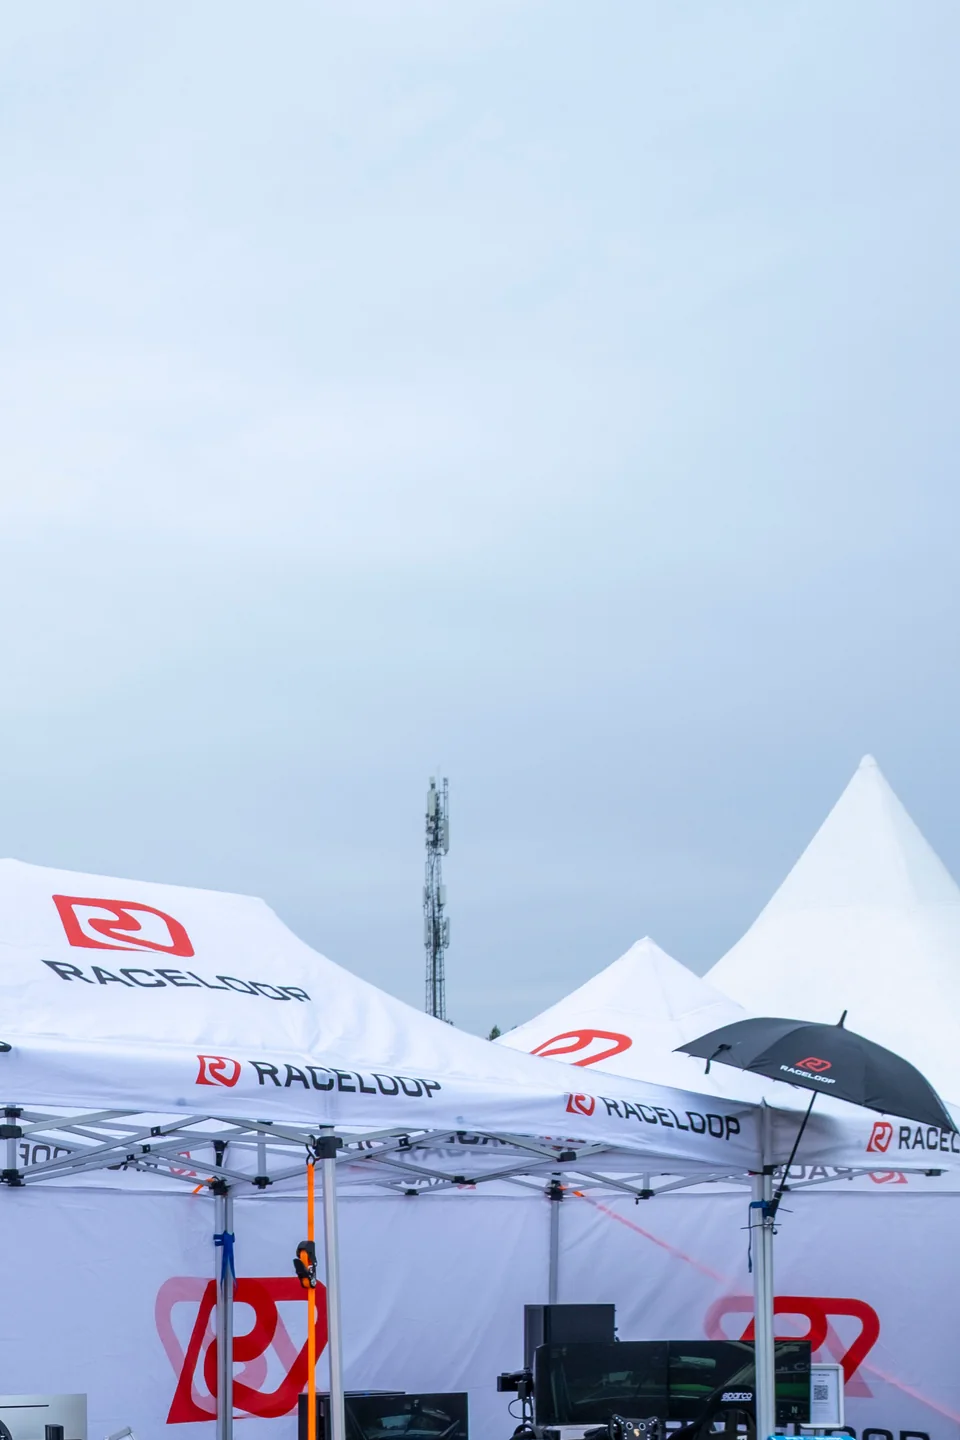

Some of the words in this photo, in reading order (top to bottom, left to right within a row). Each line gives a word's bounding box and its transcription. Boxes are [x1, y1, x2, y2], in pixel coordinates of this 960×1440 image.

[41, 959, 311, 1002] RACELOOP
[249, 1061, 441, 1098] RACELOOP
[780, 1065, 835, 1085] RACELOOP
[603, 1096, 740, 1141] RACELOOP
[722, 1391, 752, 1401] sparco
